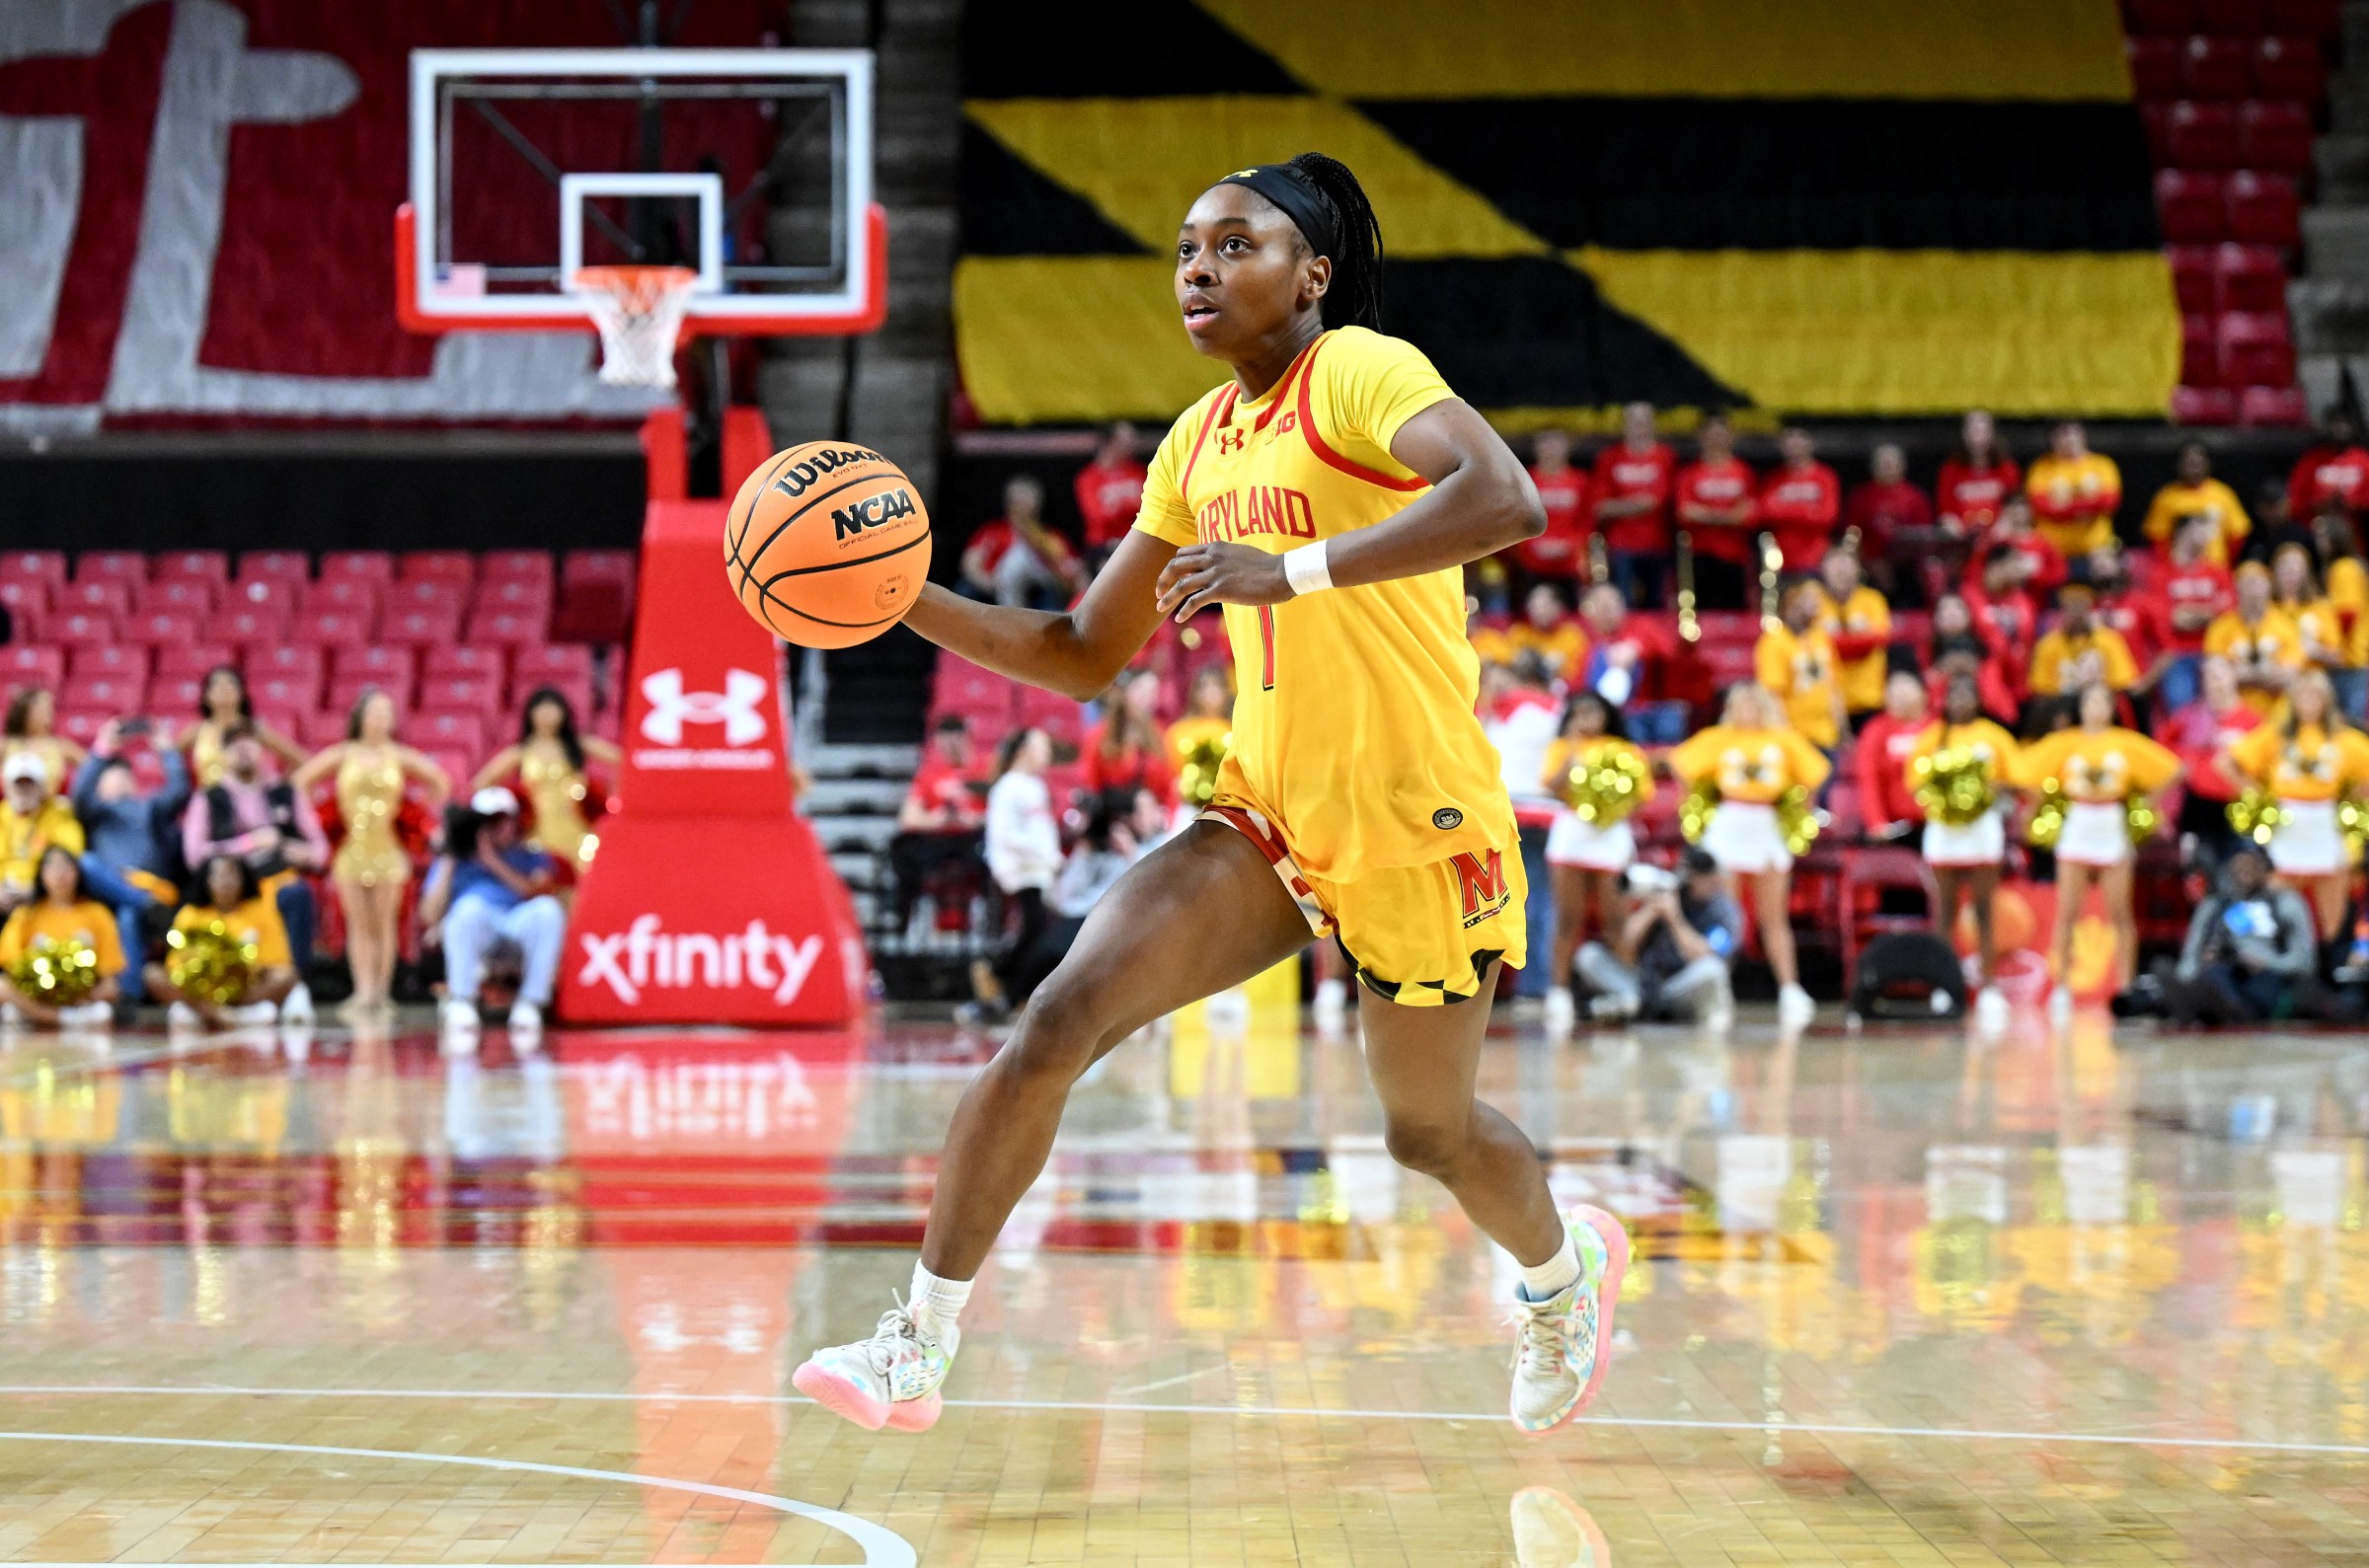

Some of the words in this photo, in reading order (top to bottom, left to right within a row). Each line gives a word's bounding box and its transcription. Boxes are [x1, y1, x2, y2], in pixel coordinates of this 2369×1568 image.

[772, 449, 892, 496] Wilson
[832, 468, 850, 479] EVO
[831, 487, 917, 542] NCAA
[839, 532, 879, 550] OFFICIAL
[880, 524, 902, 534] GAME
[1196, 485, 1316, 545] ARYLAND
[1449, 847, 1508, 920] M
[579, 914, 823, 1006] xfinity
